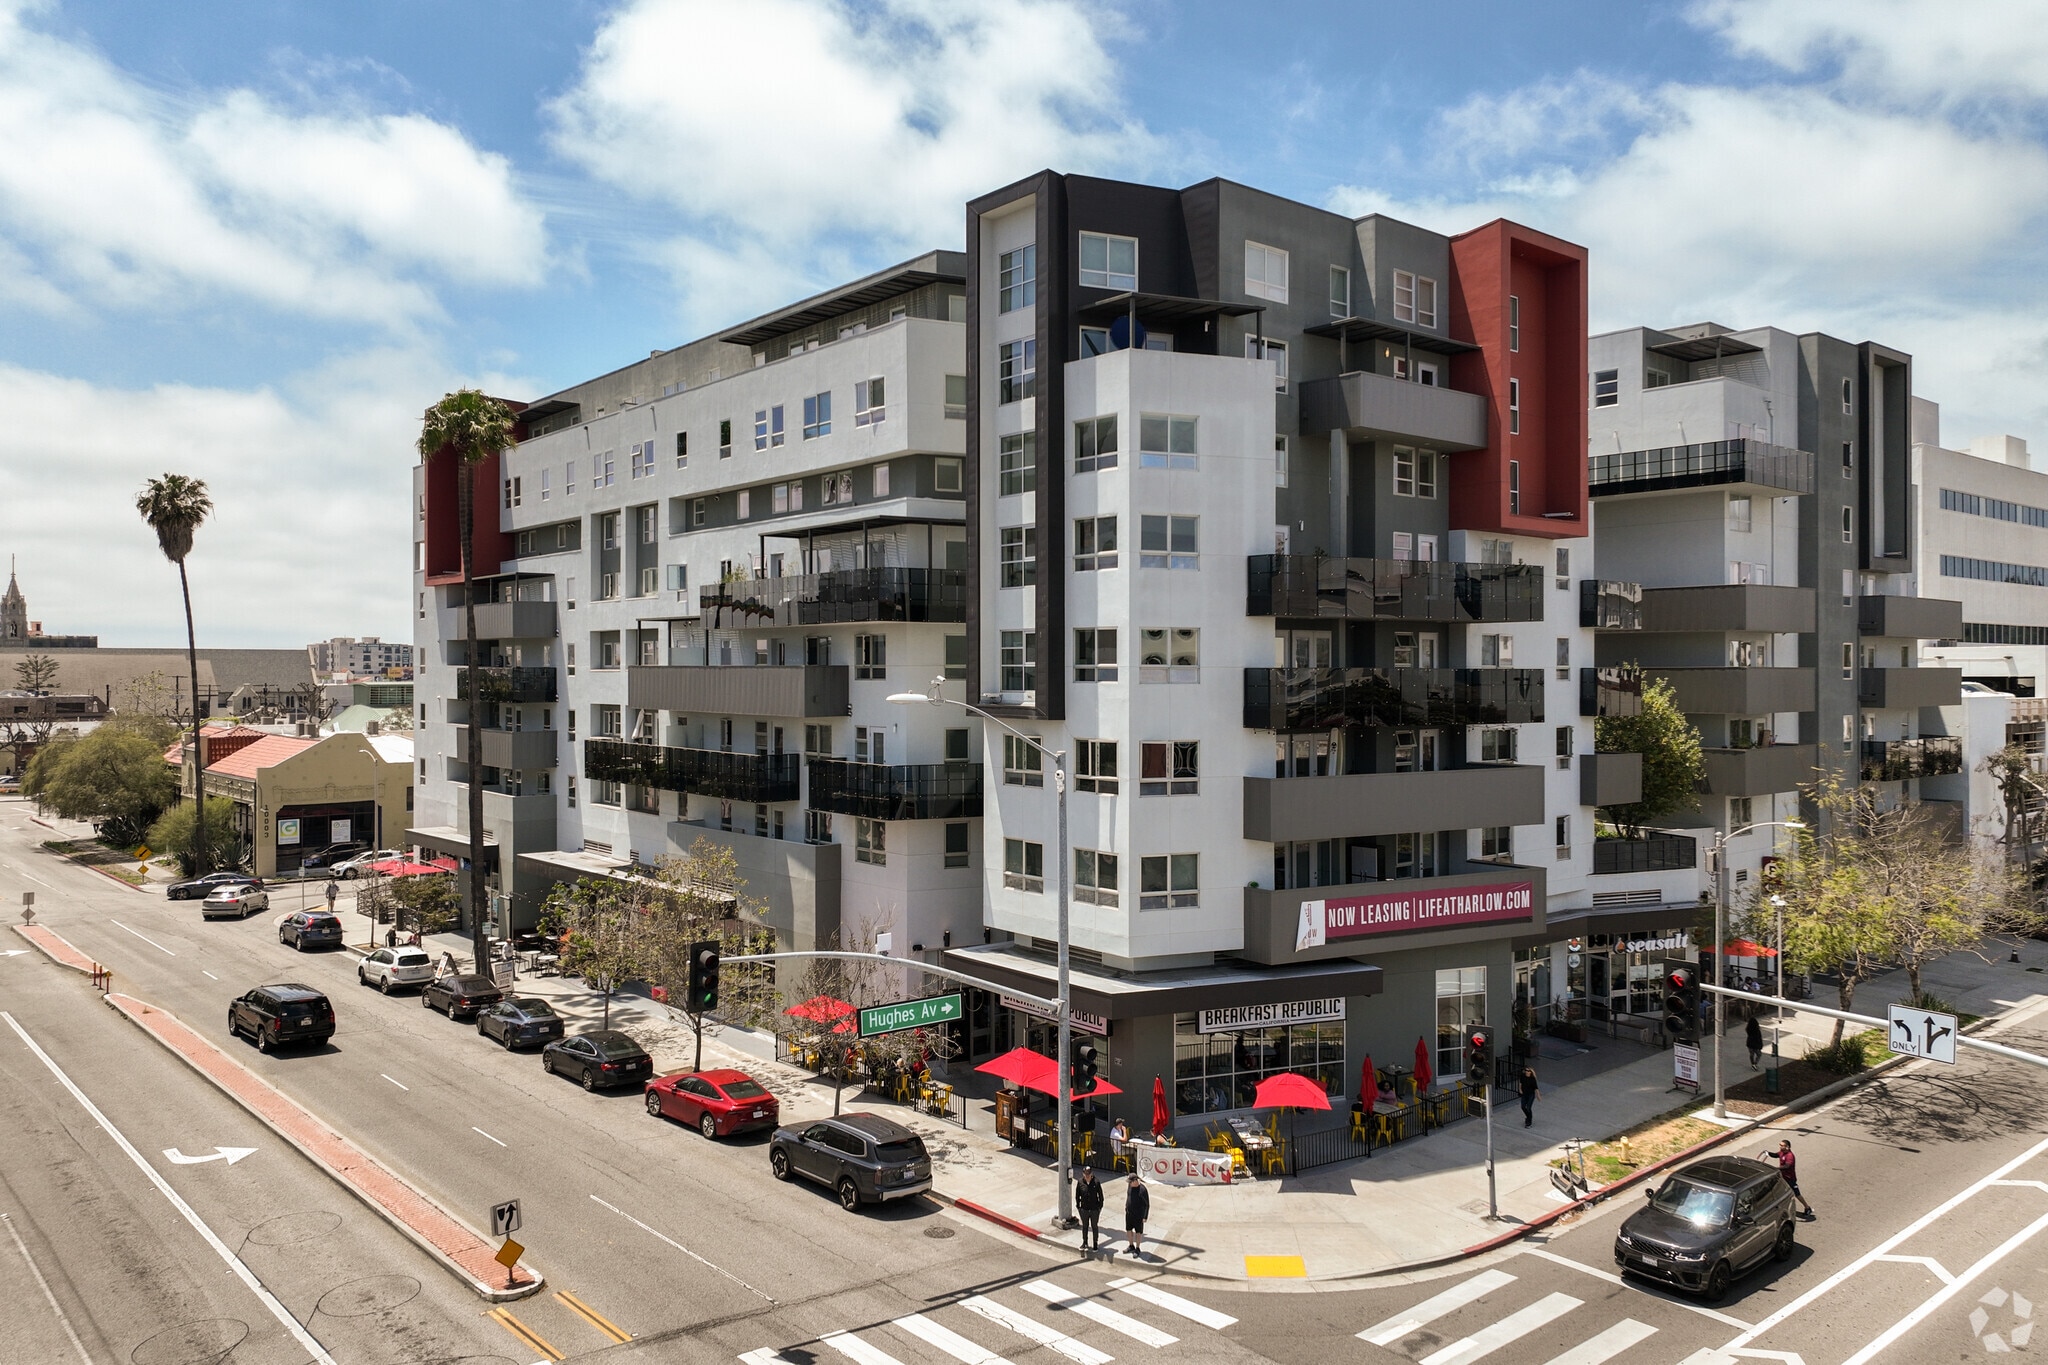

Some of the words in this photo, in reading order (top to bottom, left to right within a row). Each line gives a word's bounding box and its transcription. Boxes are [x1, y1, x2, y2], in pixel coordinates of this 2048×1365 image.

[1328, 906, 1356, 928] NOW
[1360, 900, 1410, 925] LEASING
[1418, 889, 1530, 919] LIFEATHARLOW.COM
[1625, 932, 1689, 954] seasalt
[869, 1008, 915, 1029] Hughes
[921, 1002, 937, 1019] Av
[1205, 1004, 1278, 1026] BREAKFAST
[1282, 998, 1341, 1019] REPUBLIC
[1258, 1018, 1290, 1026] CALIFORNIA
[1892, 1041, 1916, 1052] ONLY
[1154, 1158, 1216, 1178] OPEN
